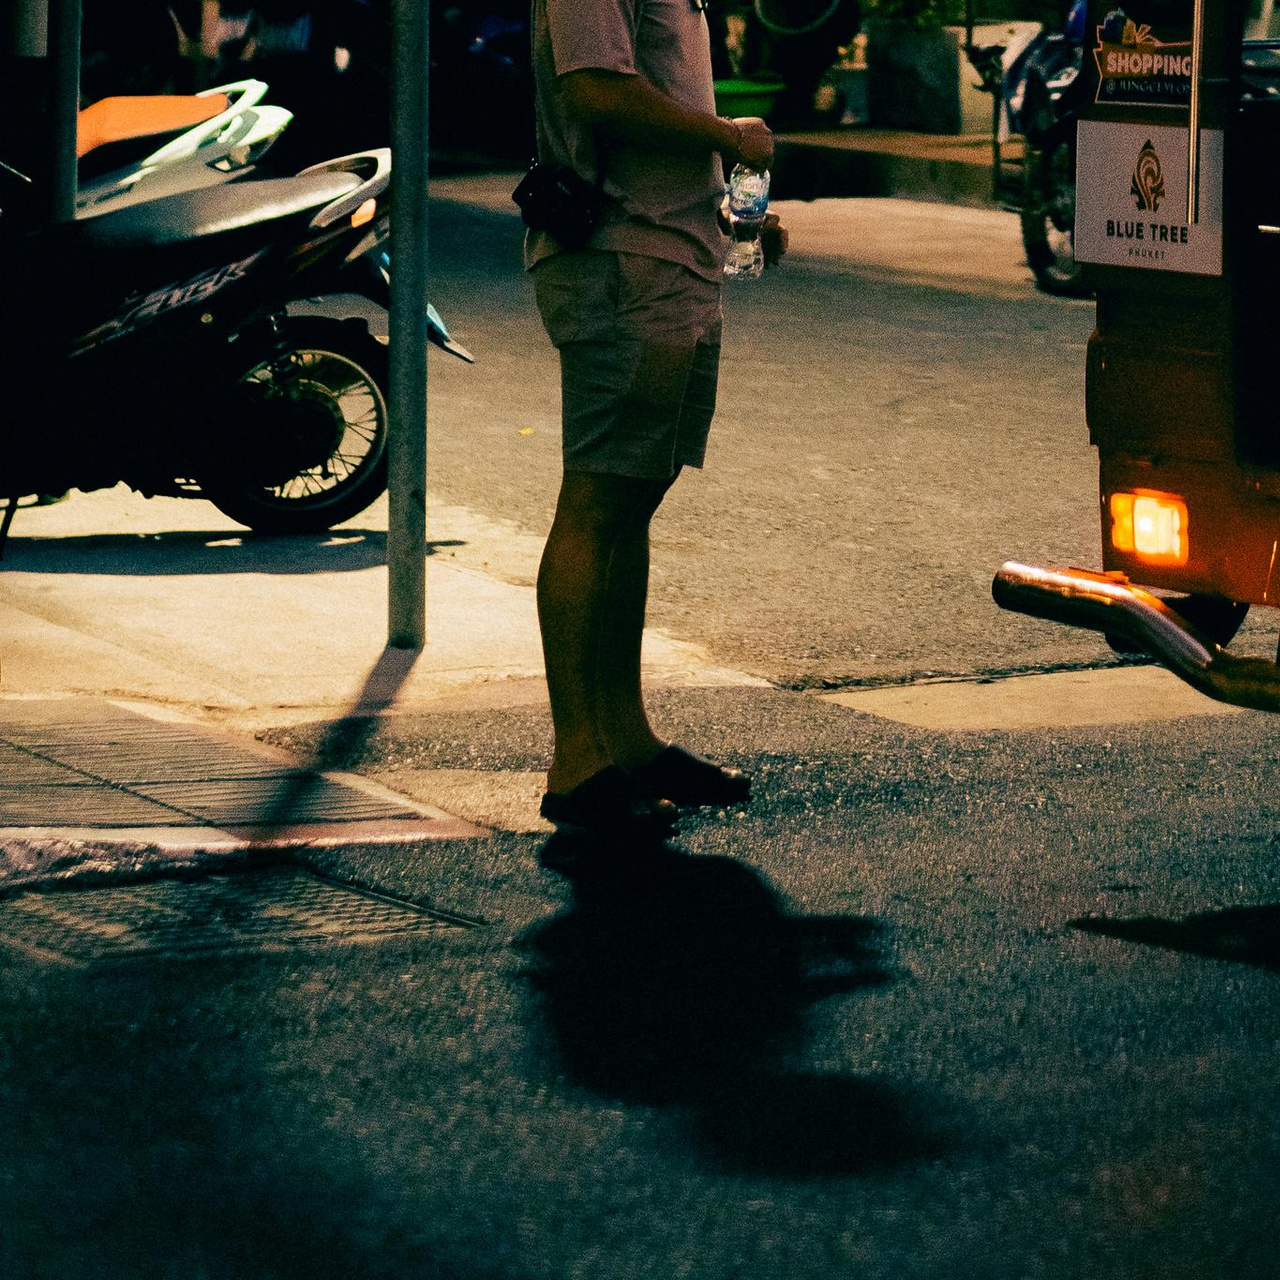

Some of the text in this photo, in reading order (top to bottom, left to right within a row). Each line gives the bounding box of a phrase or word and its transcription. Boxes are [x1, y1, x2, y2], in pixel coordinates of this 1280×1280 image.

[1106, 50, 1191, 77] SHOPPING
[1106, 219, 1188, 245] BLUE TREE
